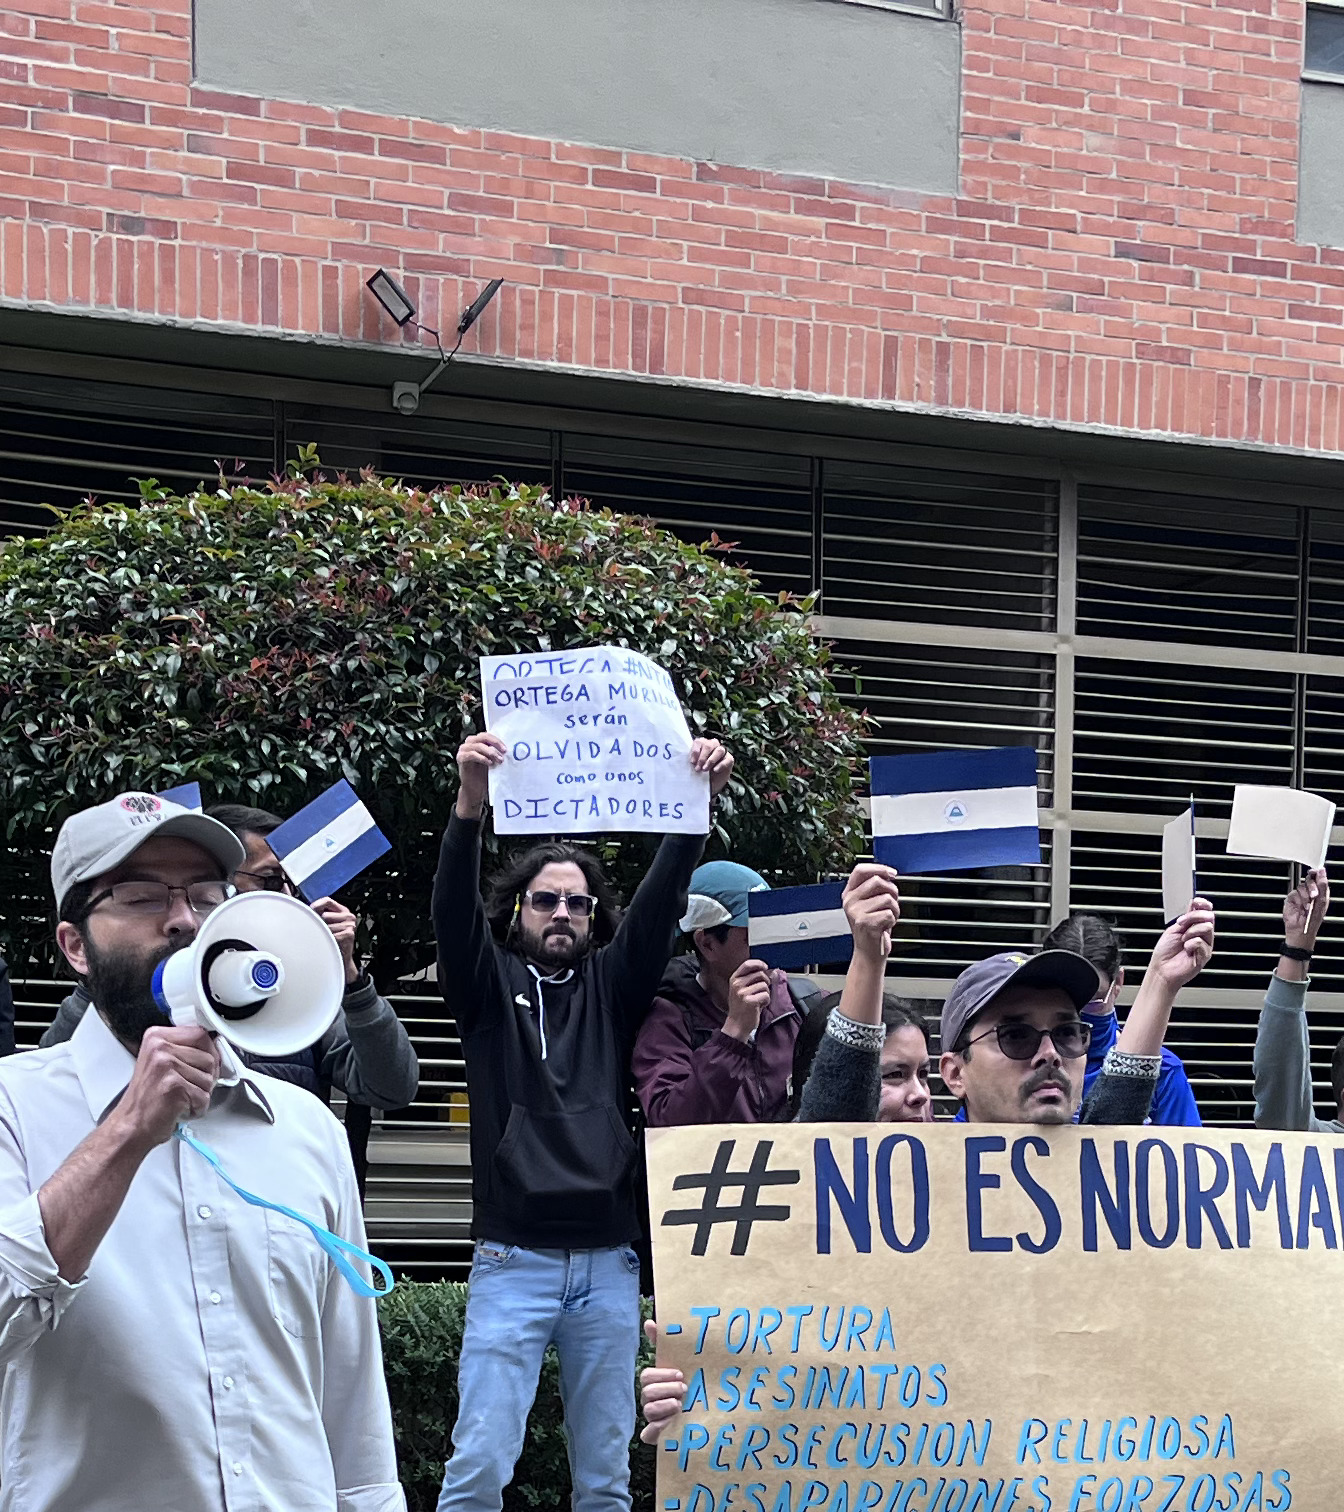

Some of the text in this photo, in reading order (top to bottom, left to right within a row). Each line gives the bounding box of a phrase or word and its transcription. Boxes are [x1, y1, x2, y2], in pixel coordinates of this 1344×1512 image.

[495, 683, 590, 707] ORTEGA
[564, 707, 627, 729] serán
[512, 738, 673, 761] OLVIDADOS
[556, 770, 644, 785] como unos
[504, 795, 684, 819] DICTADORES
[966, 1135, 1067, 1254] ES
[682, 1363, 949, 1413] ASESINATOS
[1016, 1414, 1236, 1465] RELIGIOSA
